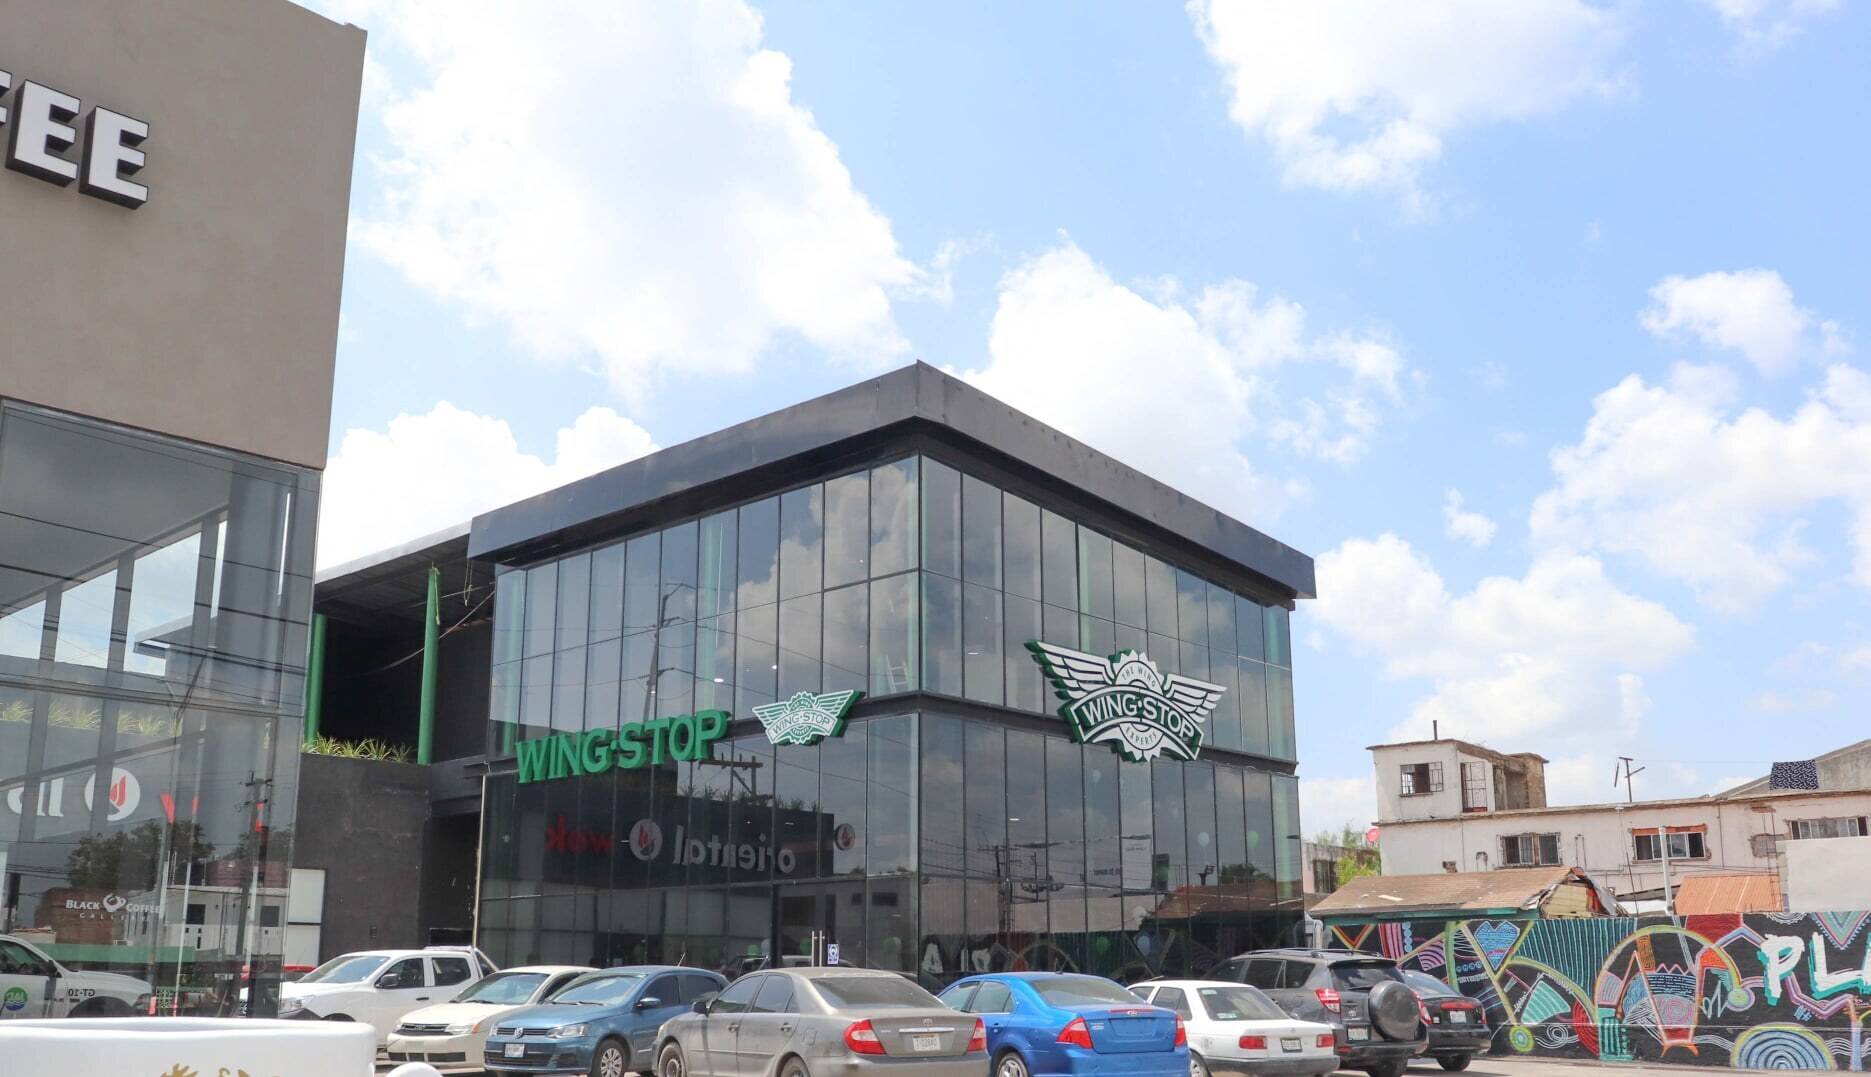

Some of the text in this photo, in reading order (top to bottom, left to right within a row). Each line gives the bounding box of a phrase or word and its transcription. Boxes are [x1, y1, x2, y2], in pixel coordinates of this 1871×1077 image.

[1125, 726, 1158, 745] EXPERTS
[65, 899, 161, 914] BLACK COFFEE
